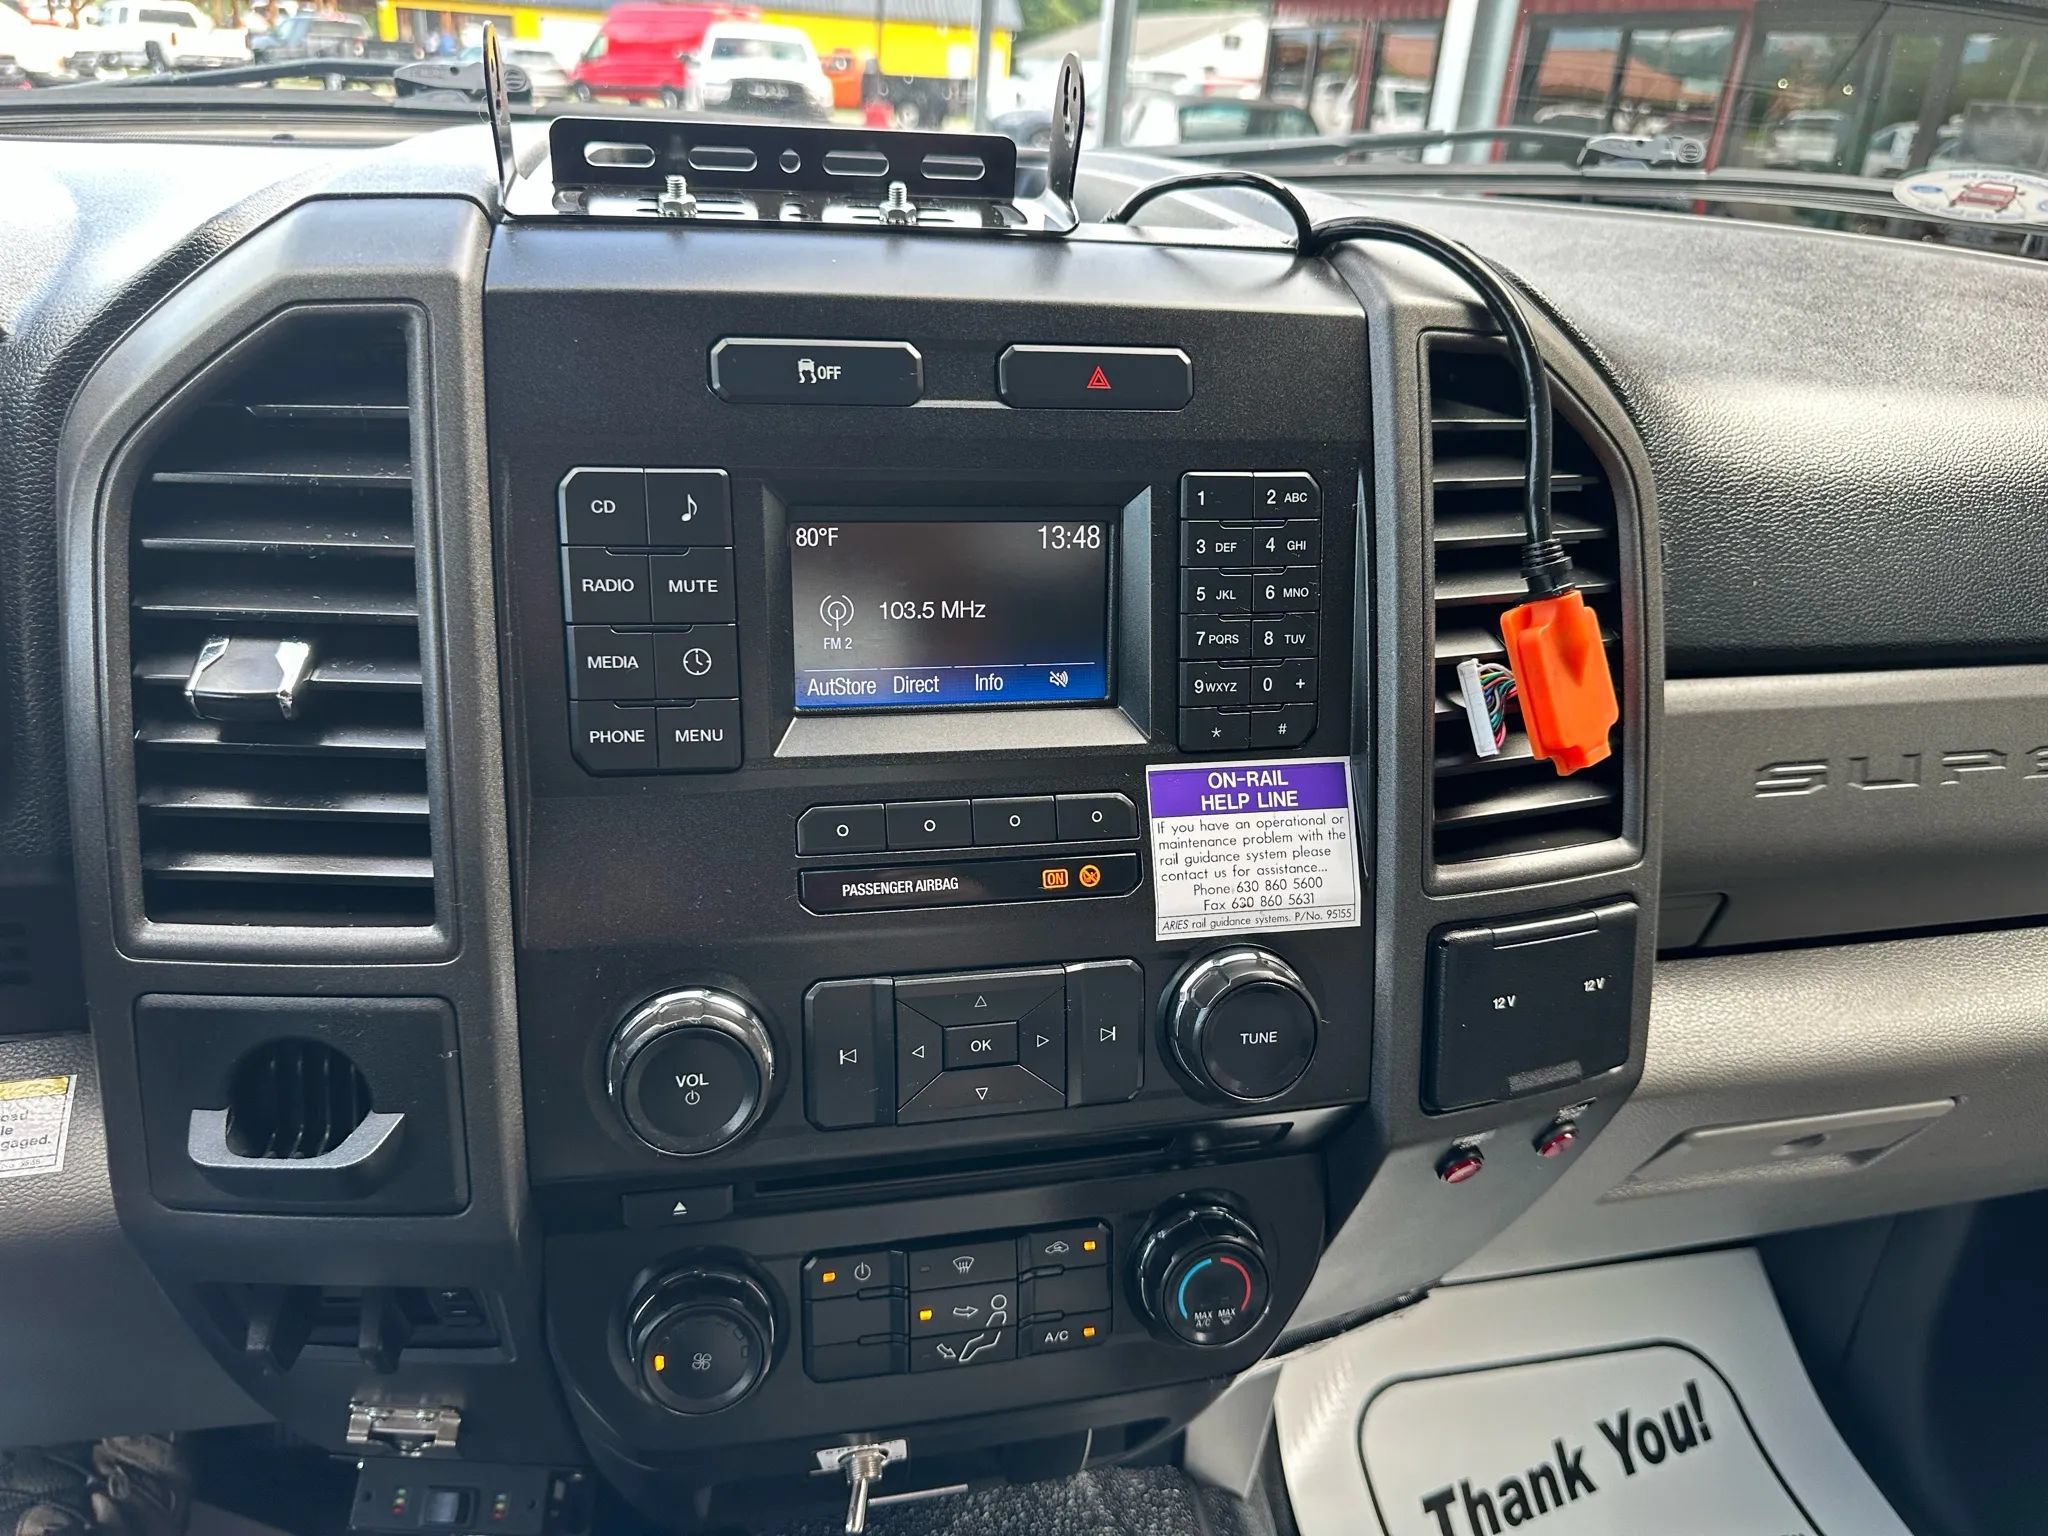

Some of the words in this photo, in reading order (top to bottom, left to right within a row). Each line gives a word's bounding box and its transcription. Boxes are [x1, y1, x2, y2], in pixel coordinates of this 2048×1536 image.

[818, 365, 842, 380] OFF
[1197, 490, 1205, 506] 1
[1266, 490, 1276, 504] 2
[1284, 492, 1308, 503] ABC
[590, 500, 616, 514] CD
[796, 527, 839, 547] 80°F
[1038, 525, 1100, 550] 13:48
[1196, 539, 1206, 554] 3
[1215, 542, 1237, 552] DEF
[1265, 538, 1276, 552] 4
[1286, 540, 1306, 550] GHI
[582, 578, 634, 592] RADIO
[668, 580, 718, 593] MUTE
[1265, 585, 1275, 600] 6
[1282, 588, 1309, 598] MNO
[1196, 587, 1206, 602] 5
[1216, 590, 1236, 600] JKL
[880, 601, 935, 620] 103.5
[941, 600, 986, 619] MHz
[824, 638, 842, 650] FM
[845, 638, 853, 650] 2
[1196, 632, 1205, 646] 7
[1208, 634, 1240, 645] PQRS
[1264, 631, 1274, 645] 8
[1284, 634, 1306, 644] TUV
[587, 656, 639, 669] MEDIA
[808, 677, 876, 696] AutStore
[893, 675, 940, 693] Direct
[975, 674, 1004, 691] Info
[1194, 679, 1204, 694] 9
[1206, 682, 1237, 692] WXYZ
[1263, 678, 1272, 692] 0
[590, 730, 646, 743] PHONE
[675, 730, 724, 742] MENU
[1208, 769, 1289, 790] ON-RAIL
[1201, 792, 1250, 812] HELP
[1257, 790, 1298, 809] LINE
[1158, 821, 1166, 834] If
[1171, 824, 1194, 836] you
[1200, 819, 1229, 832] have
[1236, 820, 1250, 830] an
[1256, 813, 1326, 830] operational
[1332, 816, 1344, 824] or
[1158, 835, 1237, 850] maintenance
[1242, 830, 1293, 847] problem
[1300, 829, 1323, 842] with
[1328, 827, 1346, 840] the
[1160, 852, 1178, 866] rail
[1184, 850, 1240, 867] guidance
[1246, 848, 1287, 863] system
[1292, 846, 1331, 861] please
[1047, 874, 1064, 885] ON
[1161, 868, 1208, 882] contact
[1214, 870, 1227, 879] us
[1233, 865, 1250, 878] for
[842, 880, 913, 896] PASSENGER
[916, 877, 959, 892] AIRBAG
[1236, 880, 1259, 893] 630
[1265, 879, 1287, 891] 860
[1293, 877, 1323, 889] 5600
[1204, 899, 1226, 911] Fax
[1231, 896, 1254, 909] 630
[1260, 895, 1283, 907] 860
[1288, 893, 1315, 906] 5631
[1162, 919, 1189, 932] ARIES
[1192, 917, 1206, 929] rail
[1210, 915, 1250, 930] guidance
[1255, 912, 1291, 925] systems.
[1294, 910, 1323, 921] P/No.
[1326, 908, 1352, 919] 95155
[1240, 1031, 1278, 1044] TUNE
[970, 1039, 992, 1052] OK
[676, 1074, 709, 1088] VOL
[0, 1134, 51, 1152] gaged.
[1194, 1311, 1213, 1321] MAX
[1218, 1308, 1236, 1317] MAX
[1196, 1318, 1210, 1328] A/C
[1044, 1330, 1069, 1343] A/C
[1421, 1436, 1598, 1536] Thank
[1594, 1378, 1713, 1477] You!
